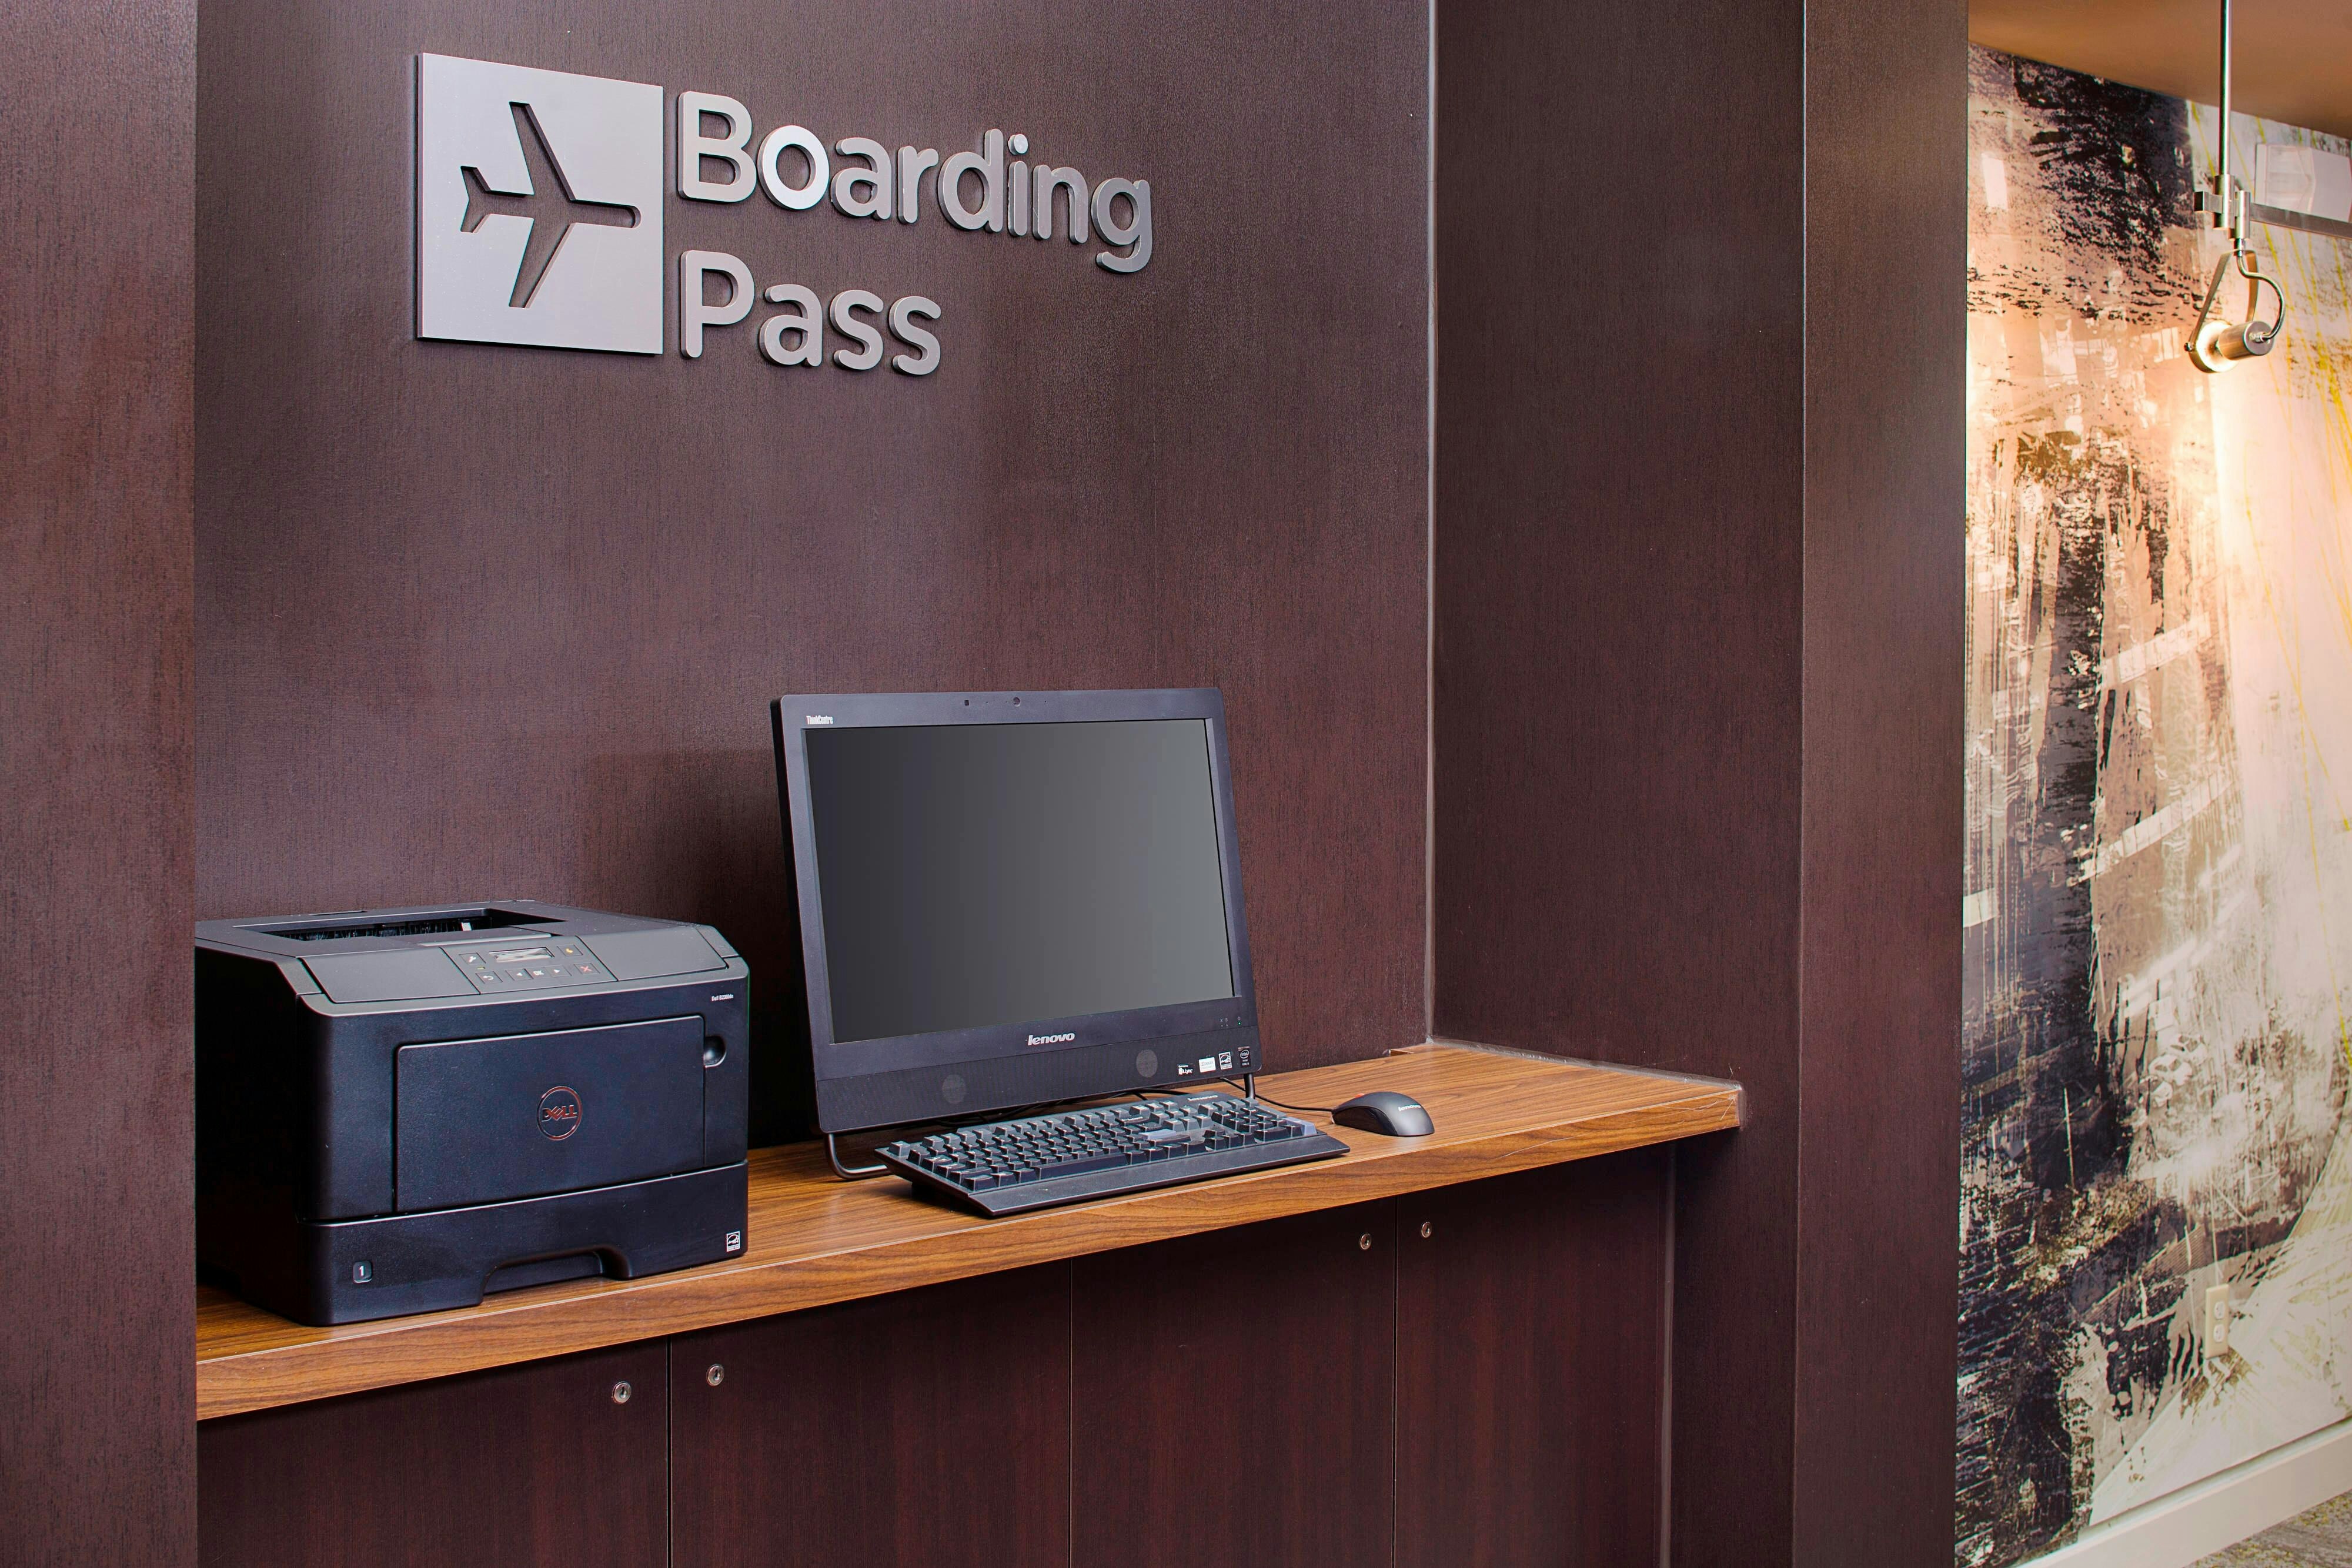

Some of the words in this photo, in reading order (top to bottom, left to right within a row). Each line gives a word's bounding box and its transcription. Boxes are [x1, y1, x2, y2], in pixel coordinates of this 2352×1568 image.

[678, 91, 1152, 273] Boarding
[681, 250, 941, 375] Pass
[1028, 1033, 1075, 1046] lenovo
[542, 1105, 577, 1122] DELL
[359, 1265, 364, 1276] 1
